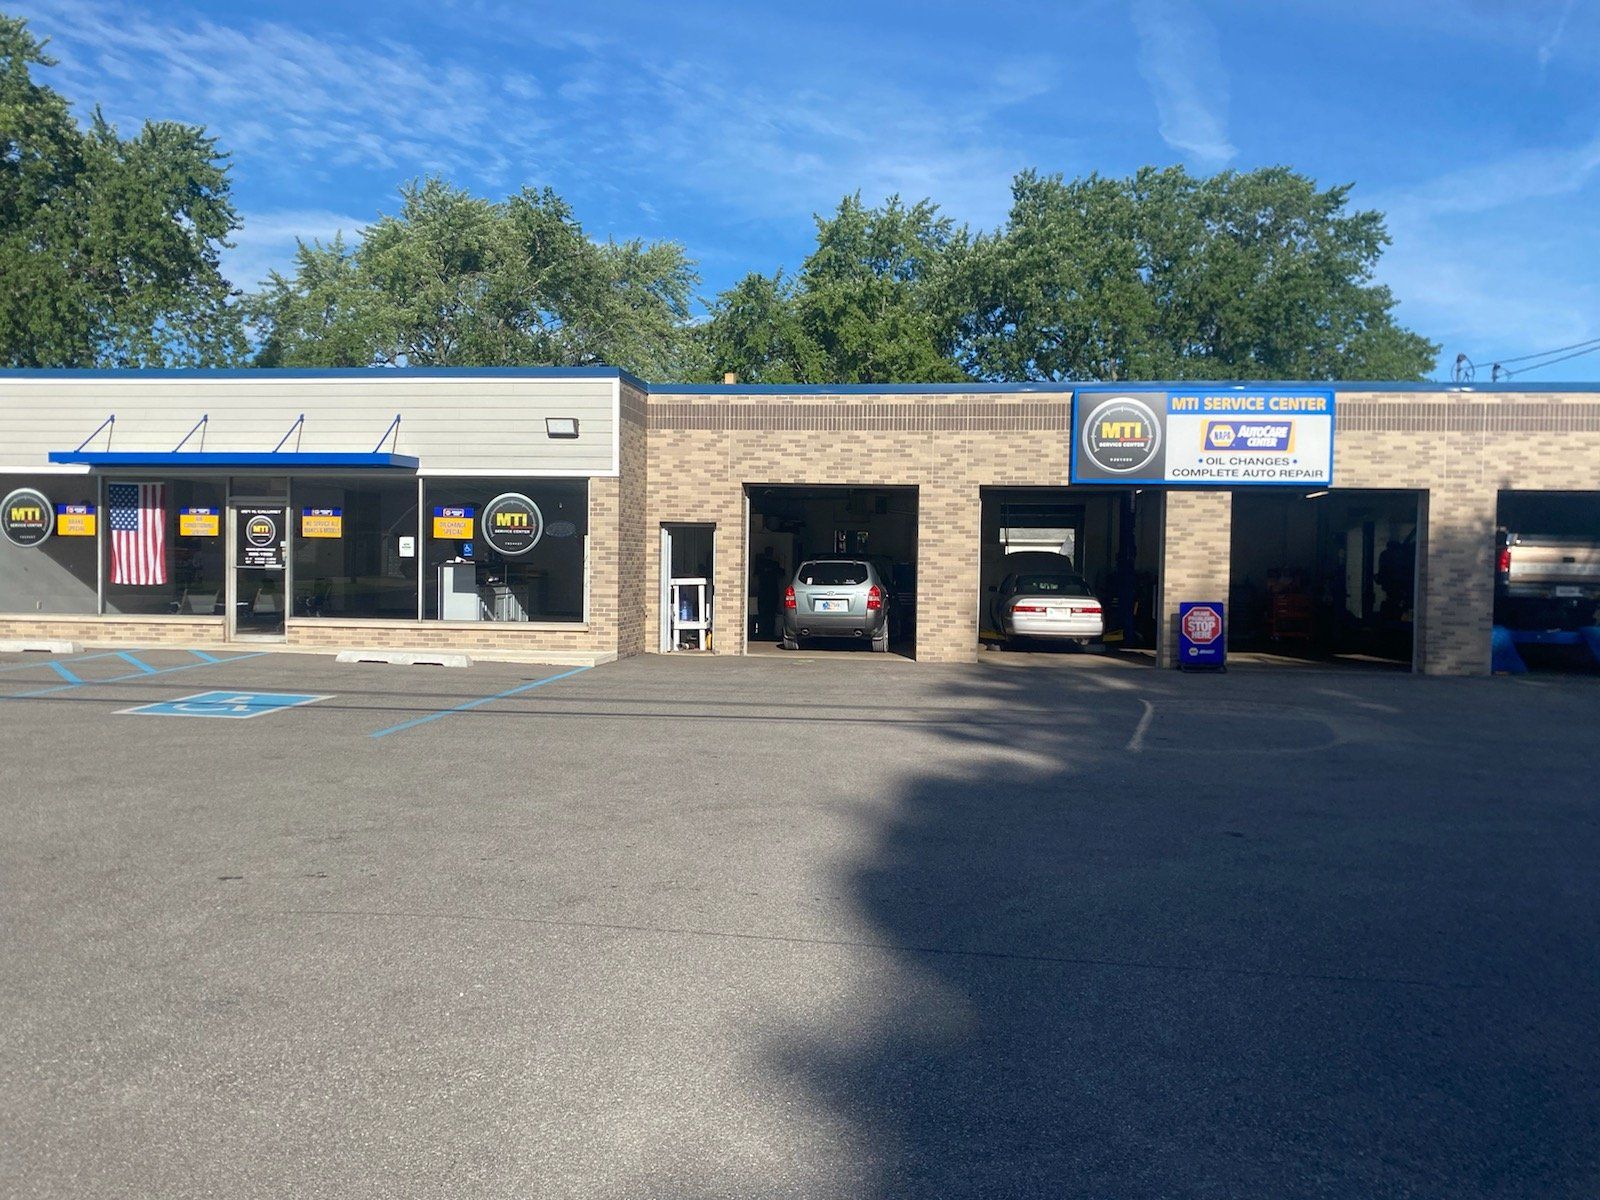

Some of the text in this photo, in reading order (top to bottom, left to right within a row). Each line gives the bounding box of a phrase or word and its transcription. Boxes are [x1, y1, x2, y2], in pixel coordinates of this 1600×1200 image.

[1172, 397, 1327, 410] MTI SERVICE CENTER
[1101, 421, 1142, 439] MTI
[1214, 430, 1231, 440] NAPA
[1247, 438, 1278, 447] CENTER
[1206, 457, 1290, 466] OIL CHANGES
[1172, 468, 1324, 478] COMPLETE AUTO REPAIR
[11, 507, 41, 521] MTI
[496, 512, 528, 527] MTI
[253, 525, 269, 533] MTI
[1188, 621, 1216, 631] STOP
[1191, 631, 1212, 639] HERE
